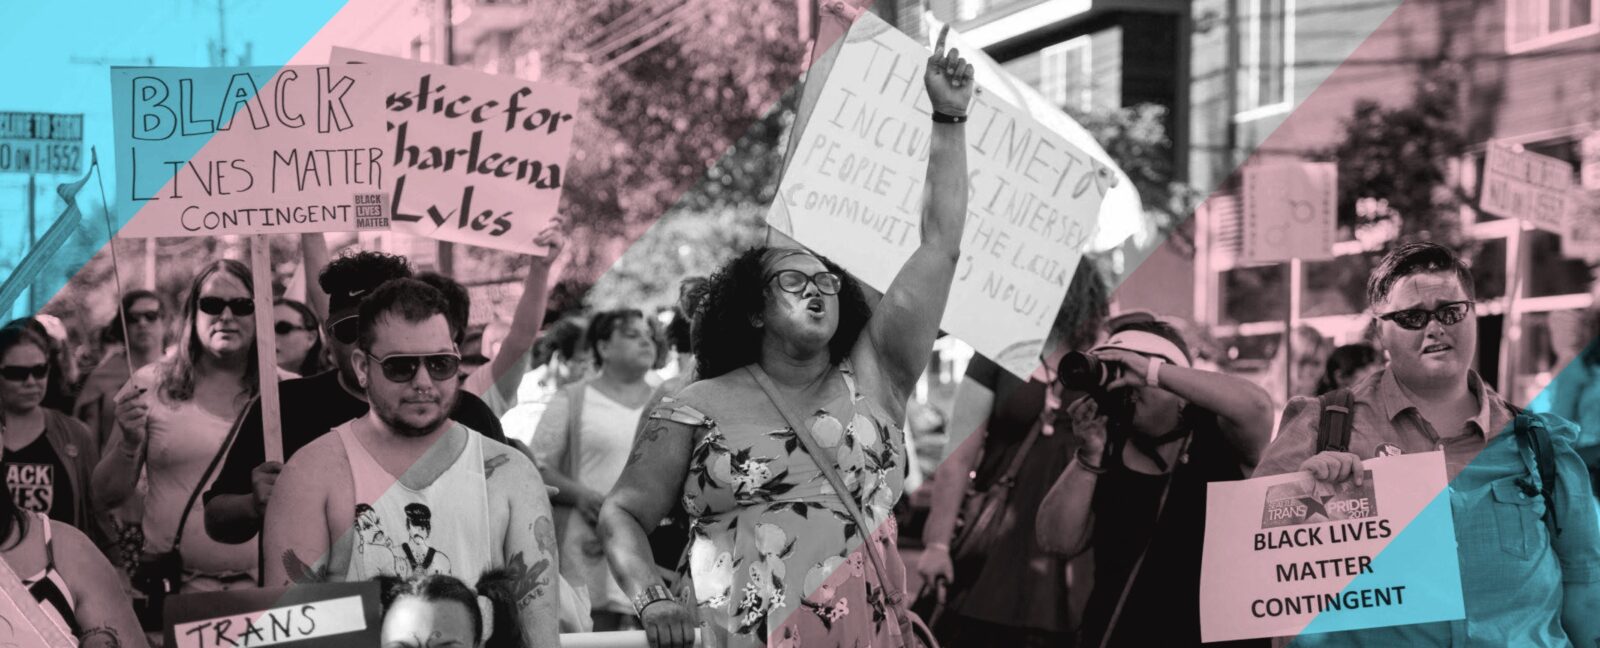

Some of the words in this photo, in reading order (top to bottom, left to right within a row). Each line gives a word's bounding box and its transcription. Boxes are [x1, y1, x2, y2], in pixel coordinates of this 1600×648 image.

[131, 66, 356, 141] BLACK
[502, 86, 573, 135] for
[386, 120, 561, 190] harleena
[803, 133, 898, 197] PEOPLE
[131, 146, 254, 201] LIVES
[271, 147, 384, 194] MATTER
[354, 194, 382, 205] BLACK
[357, 205, 382, 217] LIVES
[785, 182, 916, 247] COMMUNIT
[982, 175, 1090, 254] INTERSEX
[180, 204, 352, 232] CONTINGENT
[356, 217, 389, 229] MATTER
[6, 463, 50, 485] ACK
[1268, 504, 1307, 521] TRANS
[1328, 497, 1370, 513] PRIDE
[1348, 508, 1370, 519] 2017
[1253, 526, 1323, 551] BLACK
[1329, 518, 1392, 544] LIVES
[1275, 554, 1374, 583] MATTER
[1250, 585, 1406, 618] CONTINGENT
[185, 604, 317, 648] TRANS
